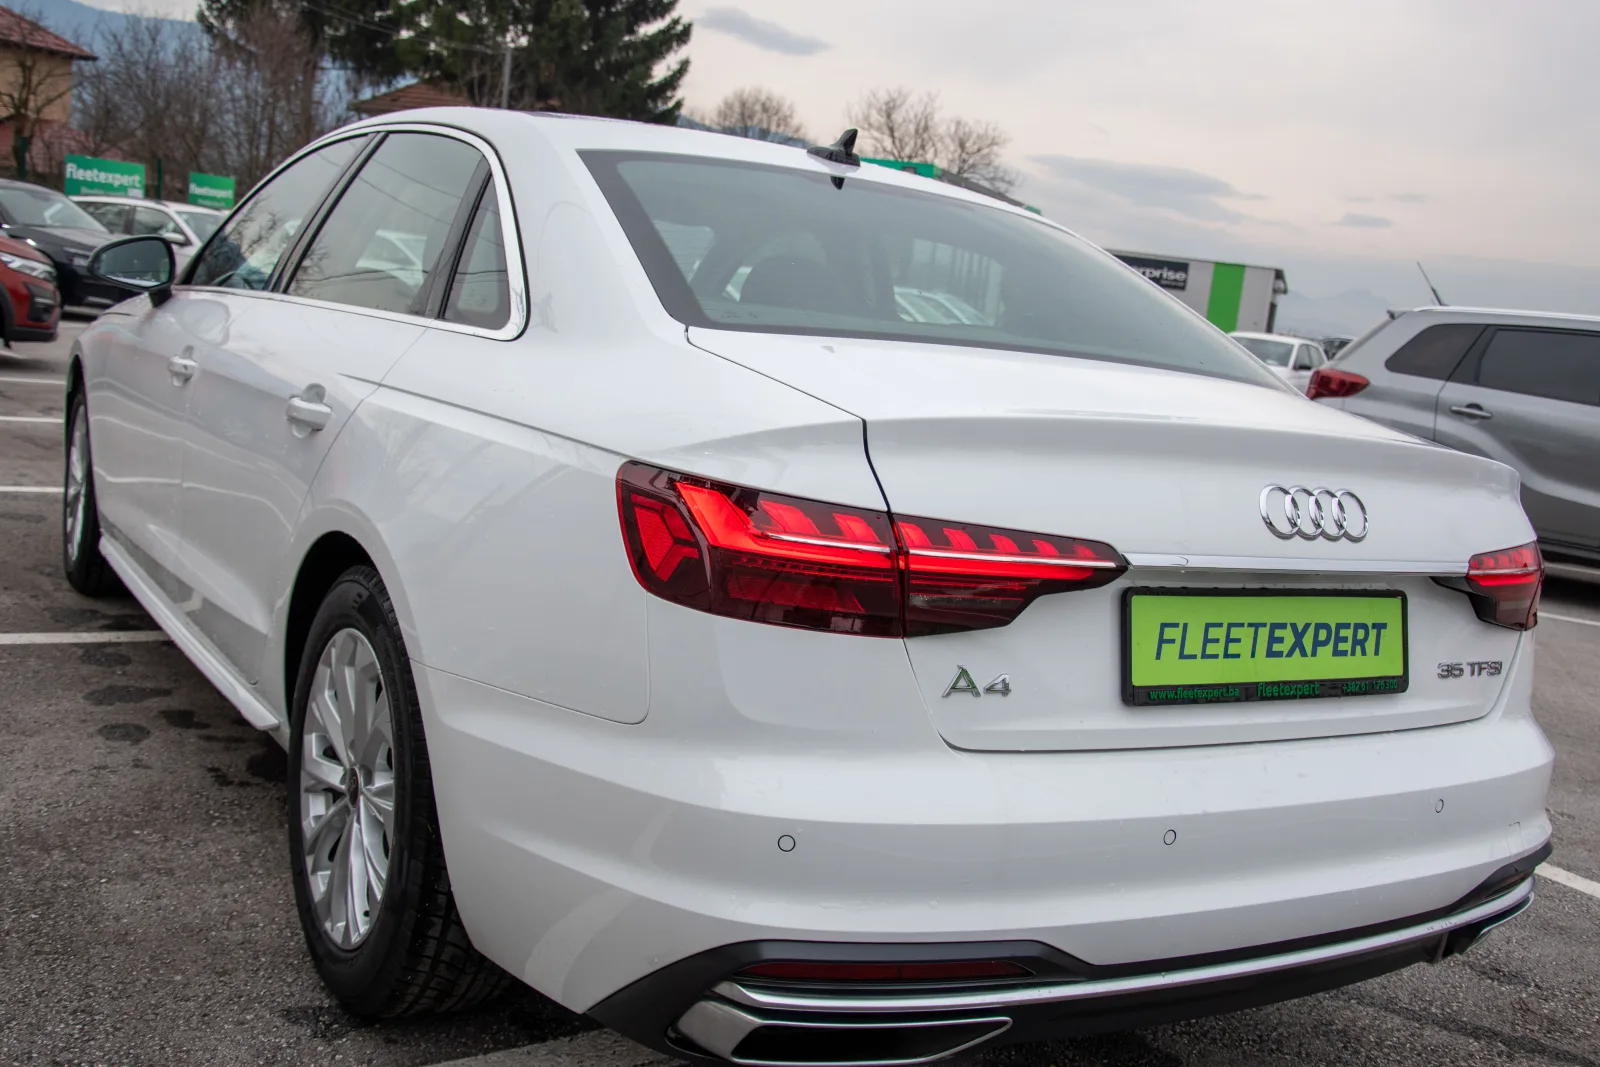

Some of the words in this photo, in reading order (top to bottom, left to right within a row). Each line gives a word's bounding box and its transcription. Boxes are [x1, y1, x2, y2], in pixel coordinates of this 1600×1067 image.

[66, 162, 141, 187] fleetexpert
[1155, 622, 1388, 660] FLEETEXPERT
[1437, 661, 1464, 679] 35
[1466, 660, 1503, 677] TFSI
[1149, 685, 1240, 700] www.fleetexpert.ba
[1257, 681, 1320, 699] fleetexpert
